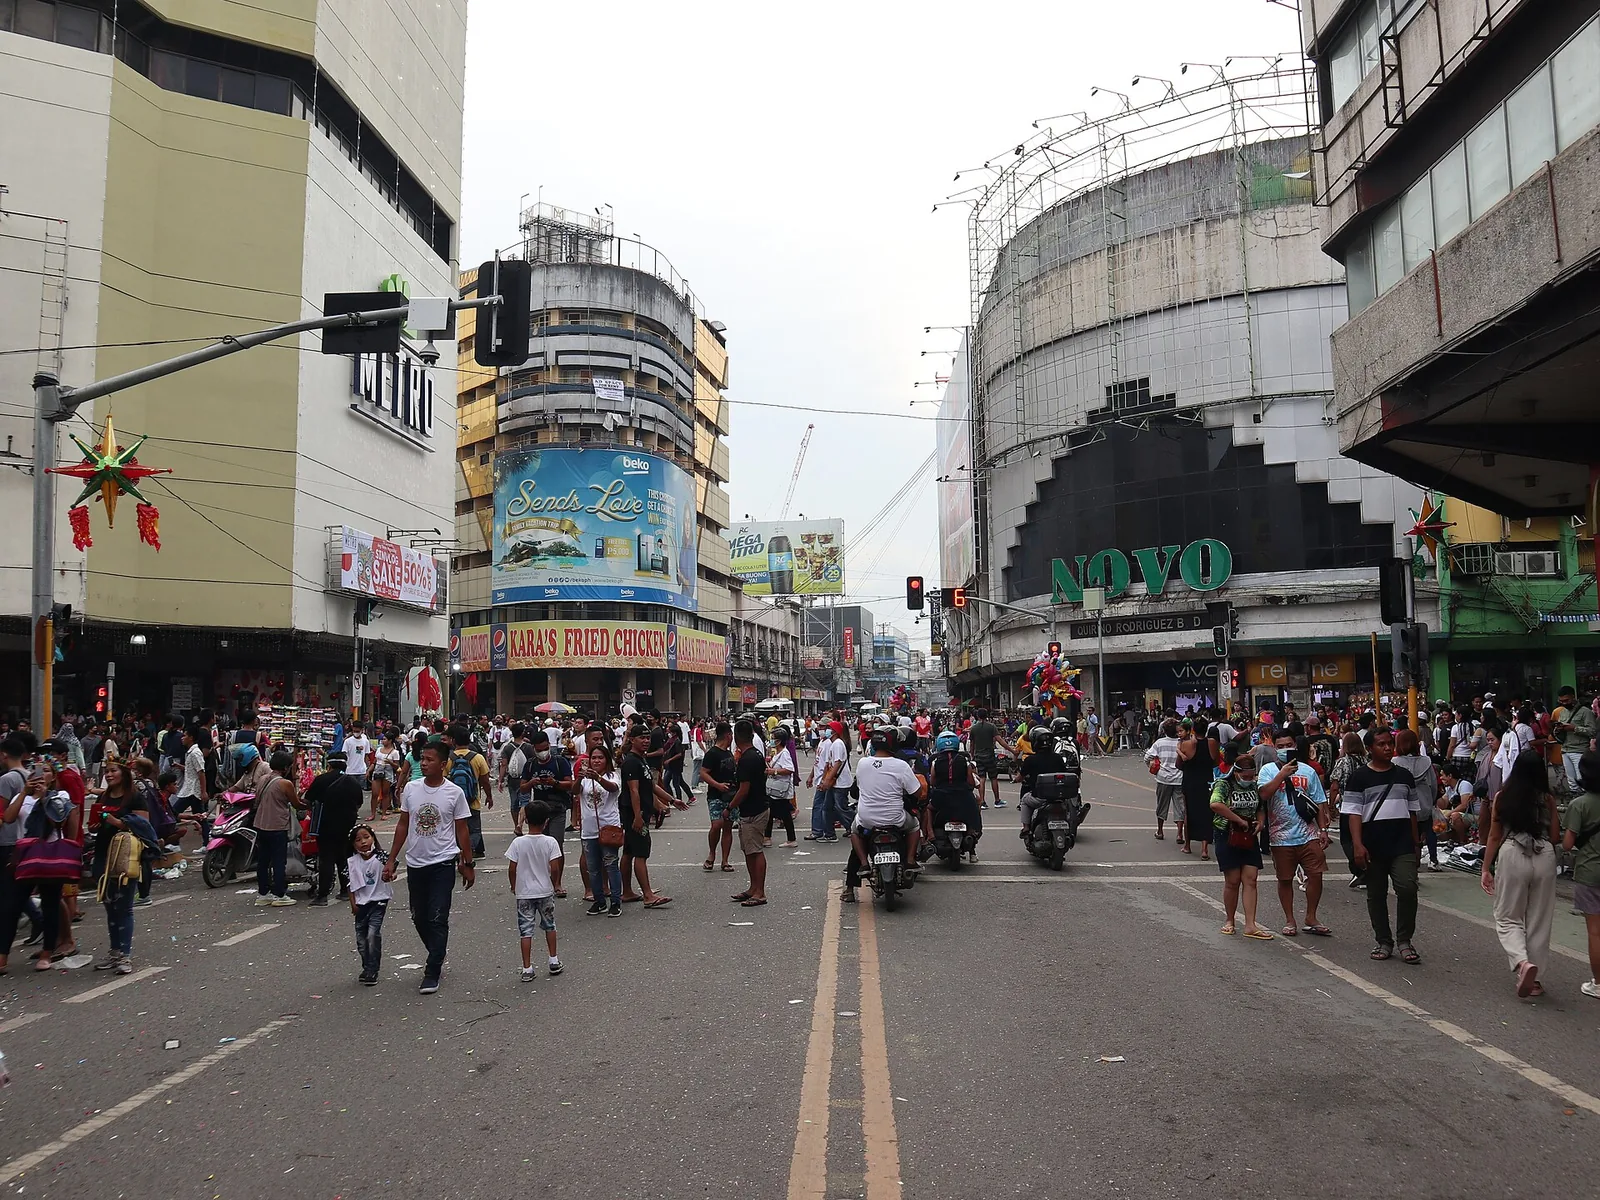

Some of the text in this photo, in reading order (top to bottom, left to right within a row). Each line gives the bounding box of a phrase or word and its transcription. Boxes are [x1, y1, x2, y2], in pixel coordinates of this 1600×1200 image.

[354, 347, 434, 438] METRO
[623, 456, 649, 470] beko
[508, 479, 644, 521] Sends Love
[739, 526, 748, 534] RC
[730, 542, 765, 559] ITRO
[372, 559, 401, 591] SALE
[403, 560, 426, 589] 50%
[1050, 538, 1232, 603] NOVO
[545, 588, 559, 596] beko
[954, 588, 965, 607] 6
[1077, 623, 1112, 636] QUIRNO
[1116, 619, 1173, 633] RODRIGUEZ
[510, 629, 557, 659] KARA'S
[564, 628, 610, 657] FRIED
[613, 629, 666, 658] CHICKEN
[1232, 790, 1257, 801] CEBU
